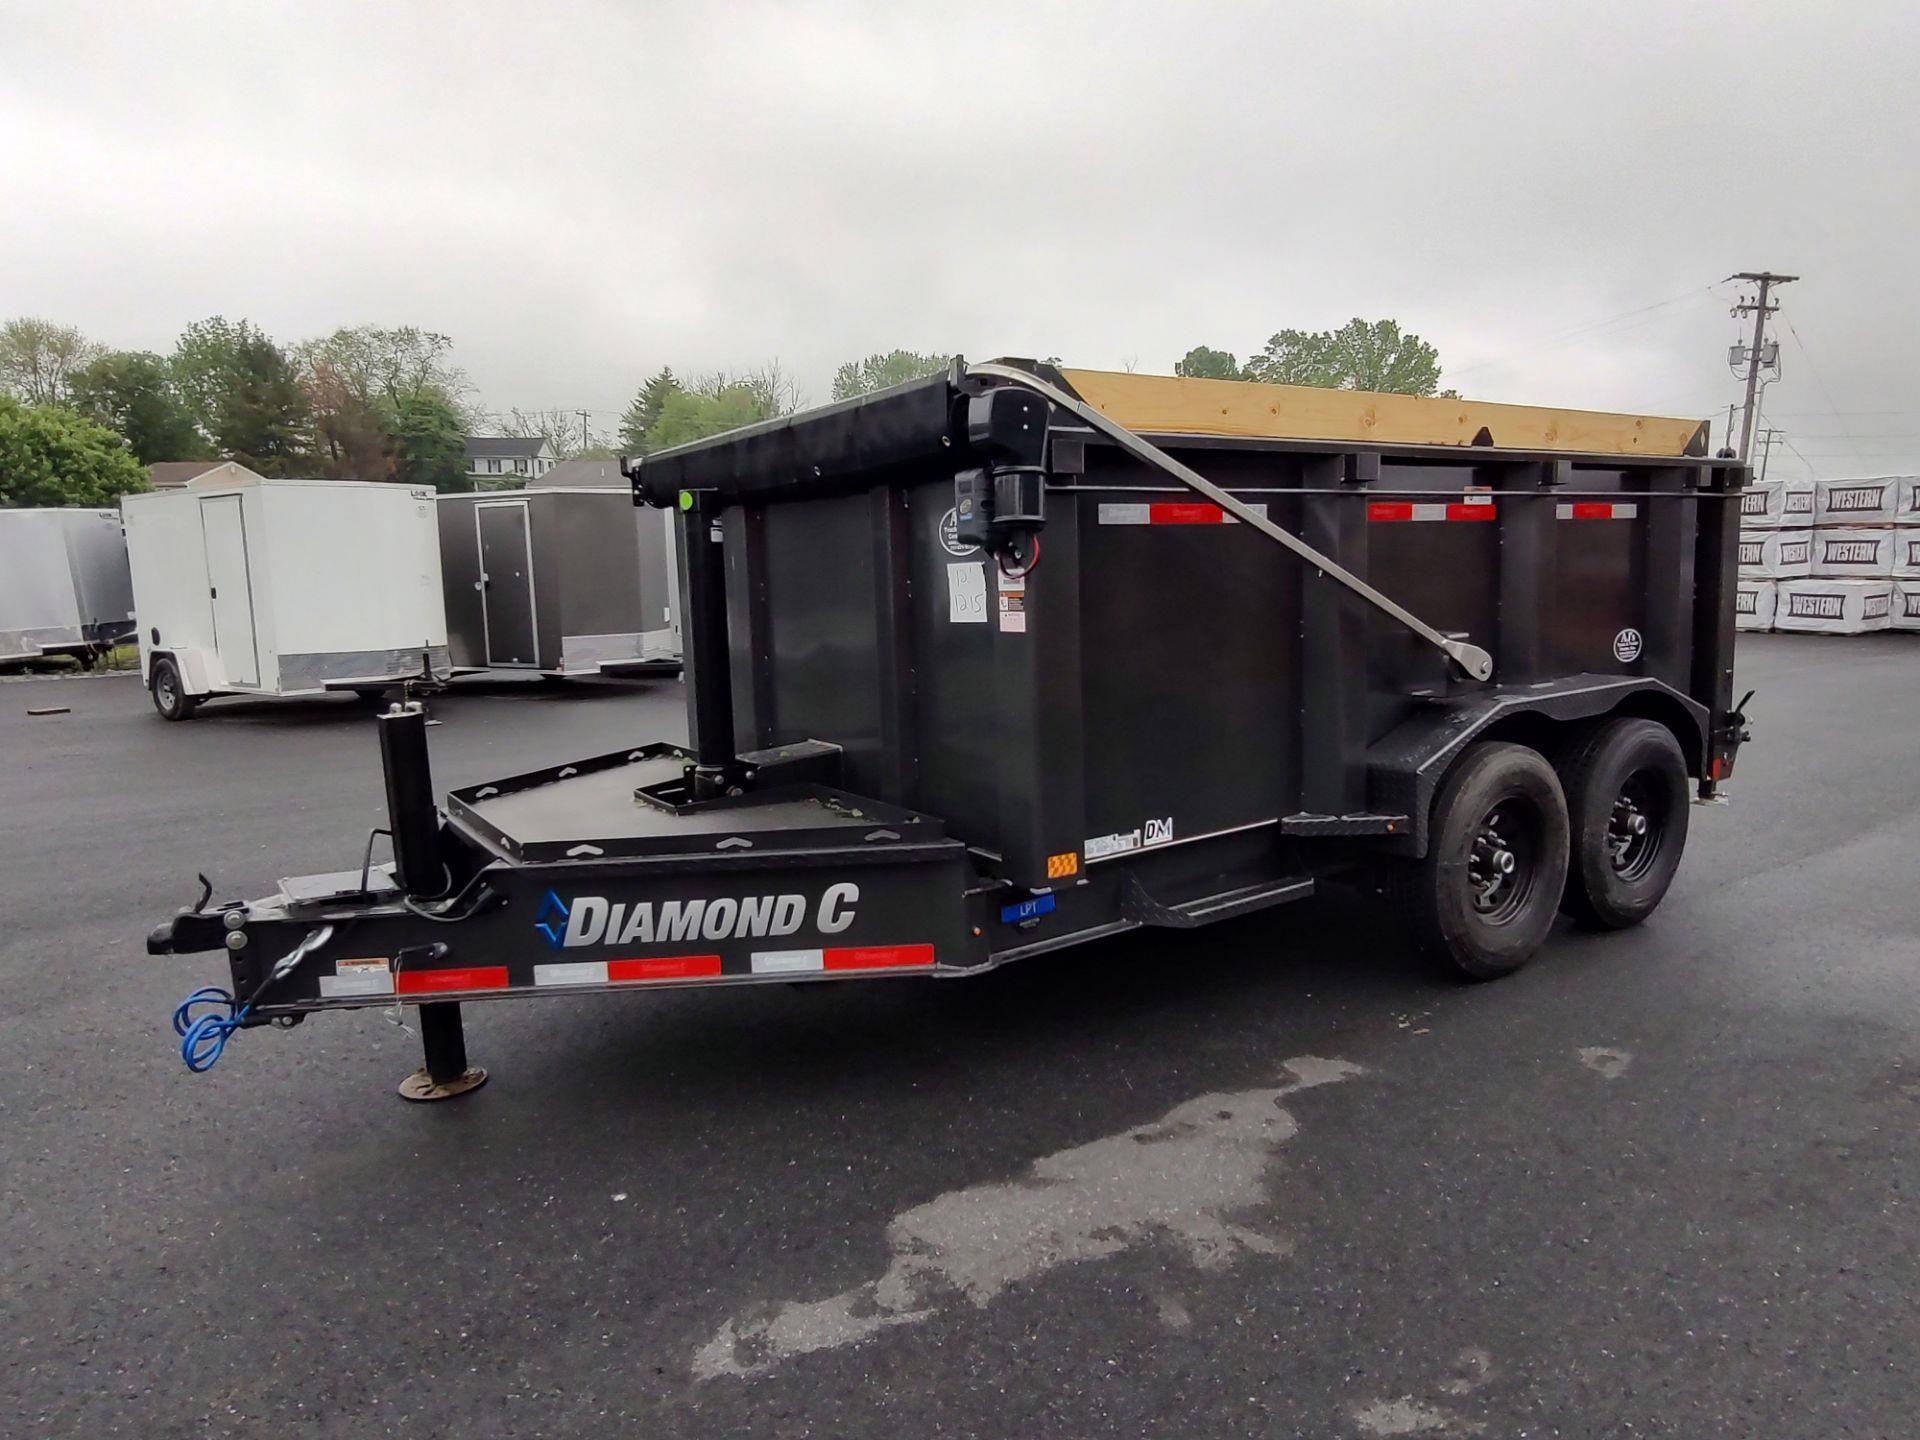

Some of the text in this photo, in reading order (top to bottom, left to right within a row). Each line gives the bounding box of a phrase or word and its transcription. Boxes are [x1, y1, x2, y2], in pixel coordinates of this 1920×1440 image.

[1831, 488, 1882, 509] WESTERN
[1828, 542, 1876, 562] WESTERN
[1792, 596, 1841, 616] WESTERN
[1143, 817, 1174, 846] DM
[563, 882, 860, 948] DIAMOND C
[1020, 901, 1037, 916] LPT
